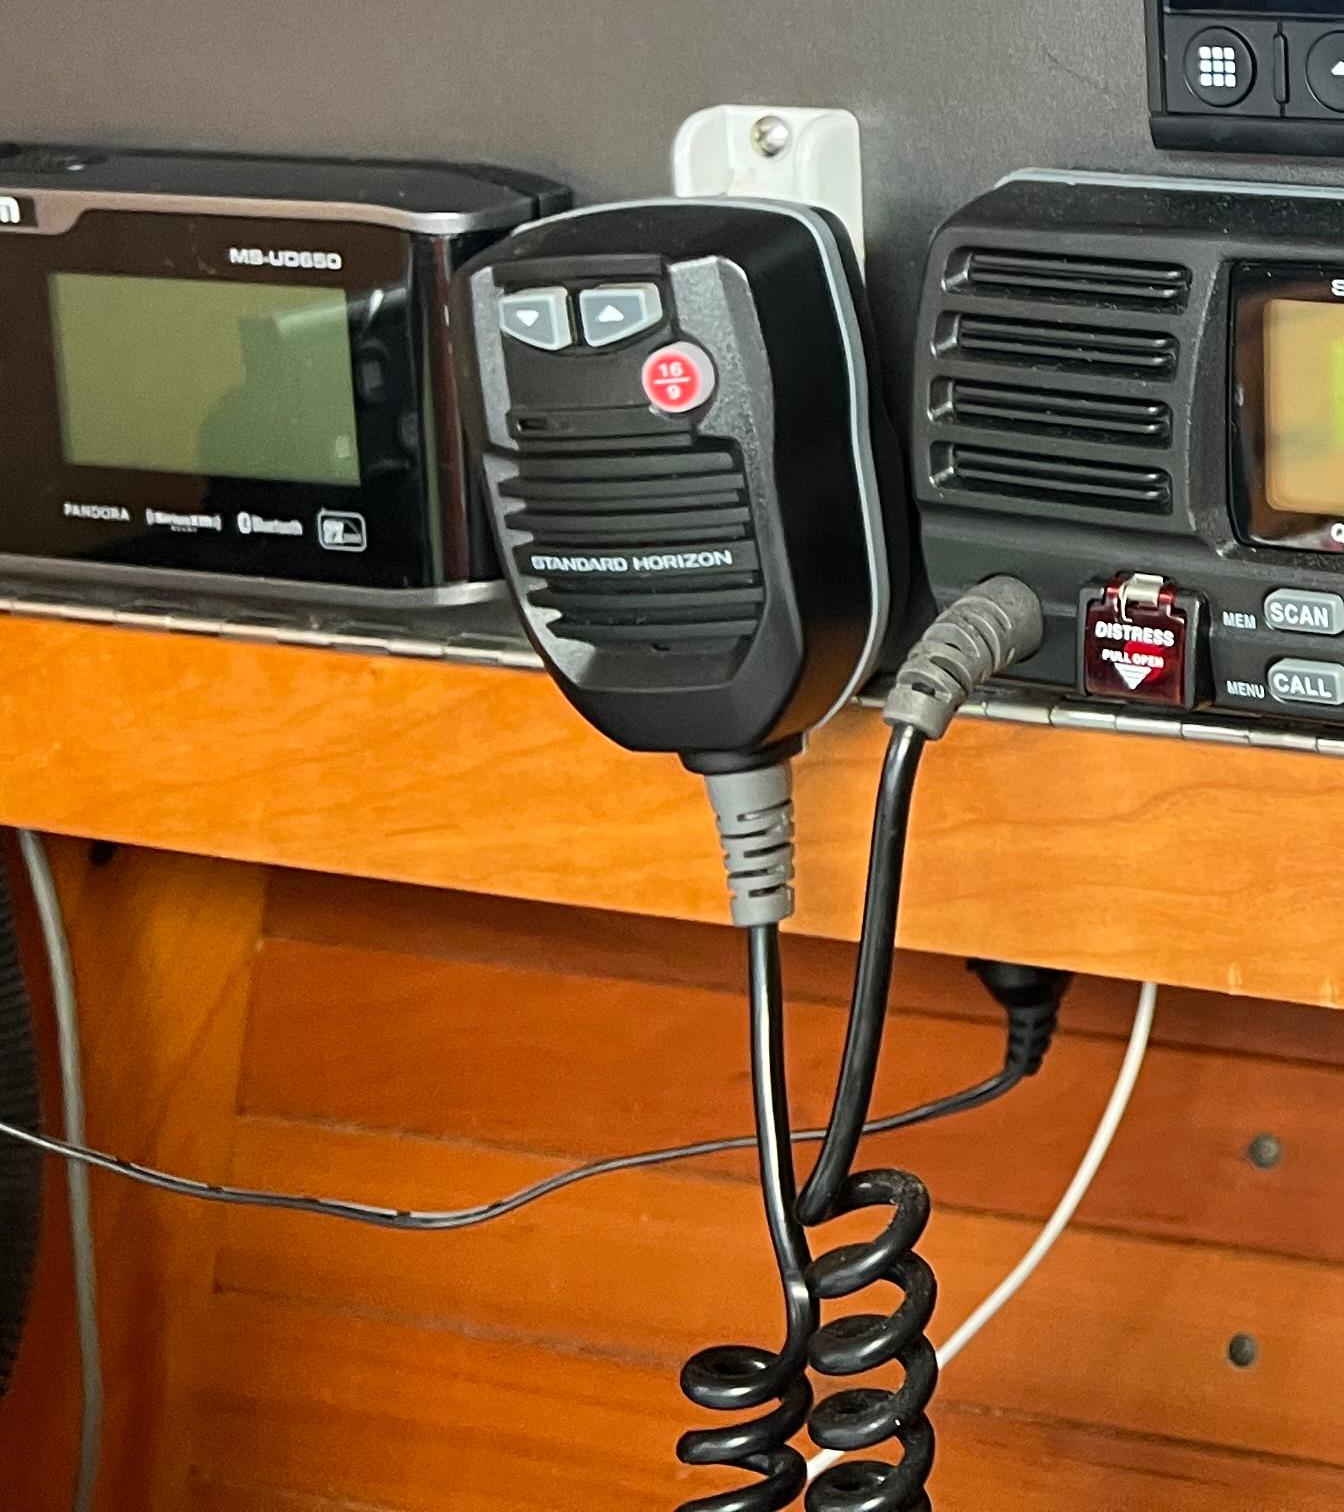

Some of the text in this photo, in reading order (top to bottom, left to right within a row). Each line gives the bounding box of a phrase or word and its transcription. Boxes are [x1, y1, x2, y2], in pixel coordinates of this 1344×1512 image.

[659, 361, 683, 378] 16
[667, 385, 681, 400] 9
[63, 502, 131, 522] PANDORA
[531, 550, 733, 572] STANDARD HORIZON
[1223, 612, 1257, 629] MEM
[1270, 601, 1329, 628] SCAN
[1095, 621, 1175, 646] DISTRESS
[1102, 648, 1164, 668] PULL OPEN
[1227, 680, 1265, 699] MENU
[1273, 673, 1332, 698] CALL
